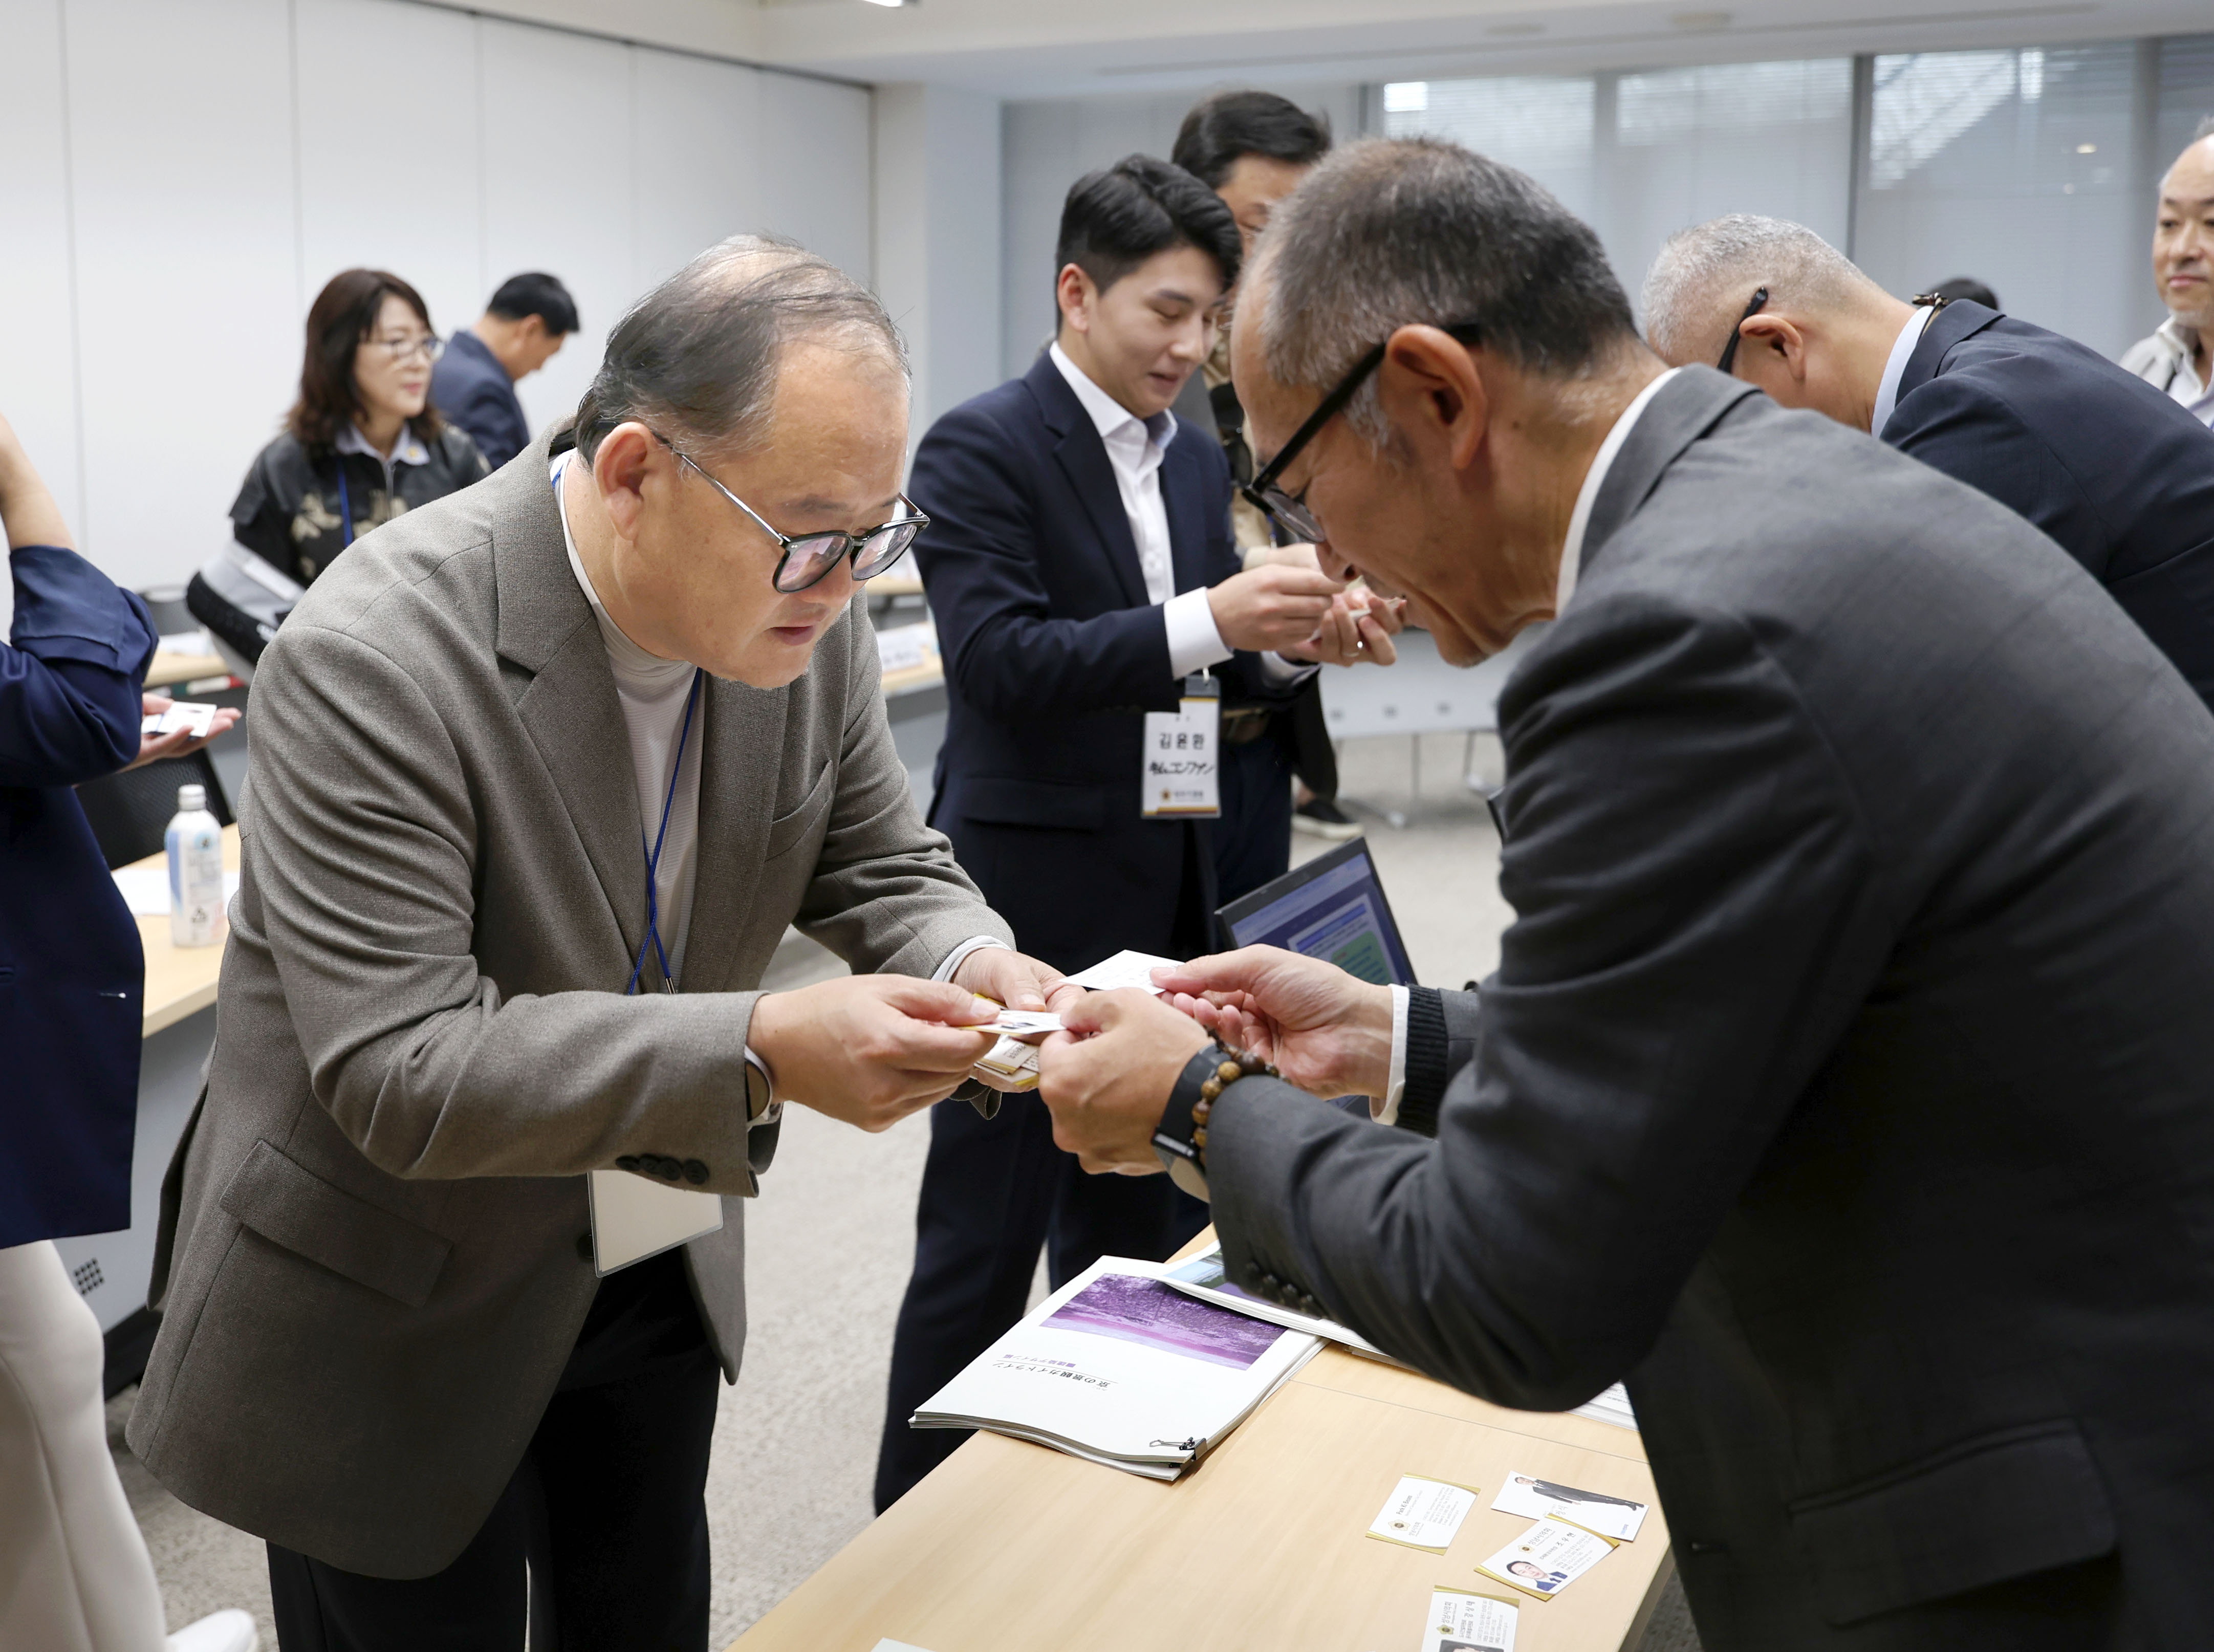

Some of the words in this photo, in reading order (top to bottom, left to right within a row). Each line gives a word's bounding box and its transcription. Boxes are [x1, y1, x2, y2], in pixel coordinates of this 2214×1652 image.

[992, 1363, 1111, 1388] 京の景観ガイドライン
[1527, 1527, 1552, 1546] 성남시의회
[1557, 1532, 1576, 1546] 조우현
[1441, 1601, 1452, 1623] 성남시의회
